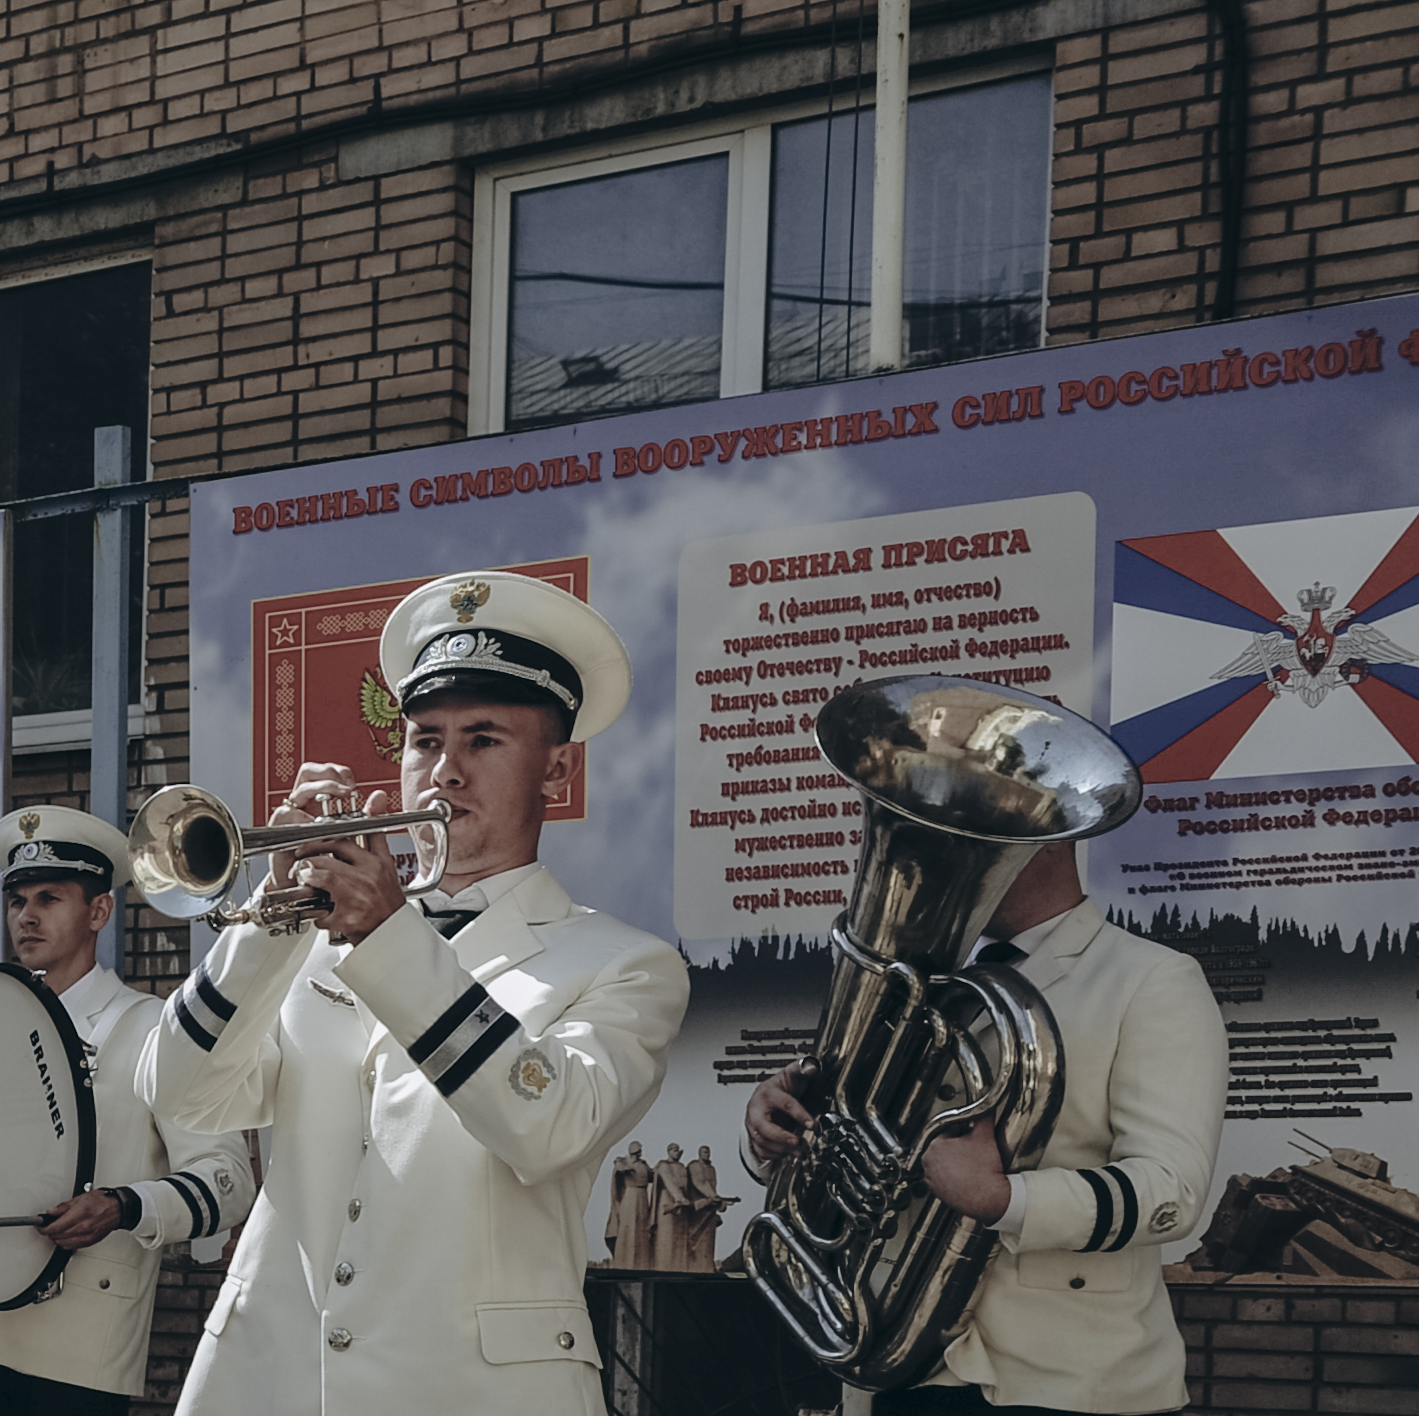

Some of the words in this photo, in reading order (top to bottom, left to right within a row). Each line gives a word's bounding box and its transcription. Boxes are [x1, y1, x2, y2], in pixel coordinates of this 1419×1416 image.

[233, 483, 400, 535] ВОЕННЫЕ
[409, 451, 601, 507] СИМВОЛЫ
[613, 402, 938, 479] ВООРУЖЕННЫХ
[952, 385, 1045, 429] СИЛ
[1057, 328, 1383, 414] РОССИЙСКОЙ
[729, 547, 872, 587] ВОЕННАЯ
[882, 528, 1031, 570] ПРИСЯГА
[758, 602, 774, 625] Я,
[779, 597, 867, 624] (фамилия,
[871, 590, 909, 611] имя,
[914, 576, 1001, 605] отчество)
[723, 627, 840, 657] торжественно
[844, 617, 928, 646] присягаю
[932, 615, 953, 632] на
[957, 606, 1040, 633] верность
[695, 665, 754, 687] своему
[757, 656, 844, 680] Отечеству
[858, 638, 961, 669] Российской
[711, 691, 779, 714] Клянусь
[782, 687, 830, 706] свято
[699, 714, 795, 742] Российской
[726, 744, 820, 772] требования
[721, 777, 791, 801] приказы
[1143, 795, 1199, 814] Флаг
[1205, 783, 1376, 809] Министерства
[689, 808, 756, 831] Клянусь
[760, 799, 838, 826] достойно
[1177, 809, 1316, 837] Российской
[734, 831, 845, 858] мужественно
[725, 859, 850, 883] независимость
[732, 887, 780, 914] строй
[784, 888, 847, 908] России,
[29, 1029, 65, 1140] BRAHNER
